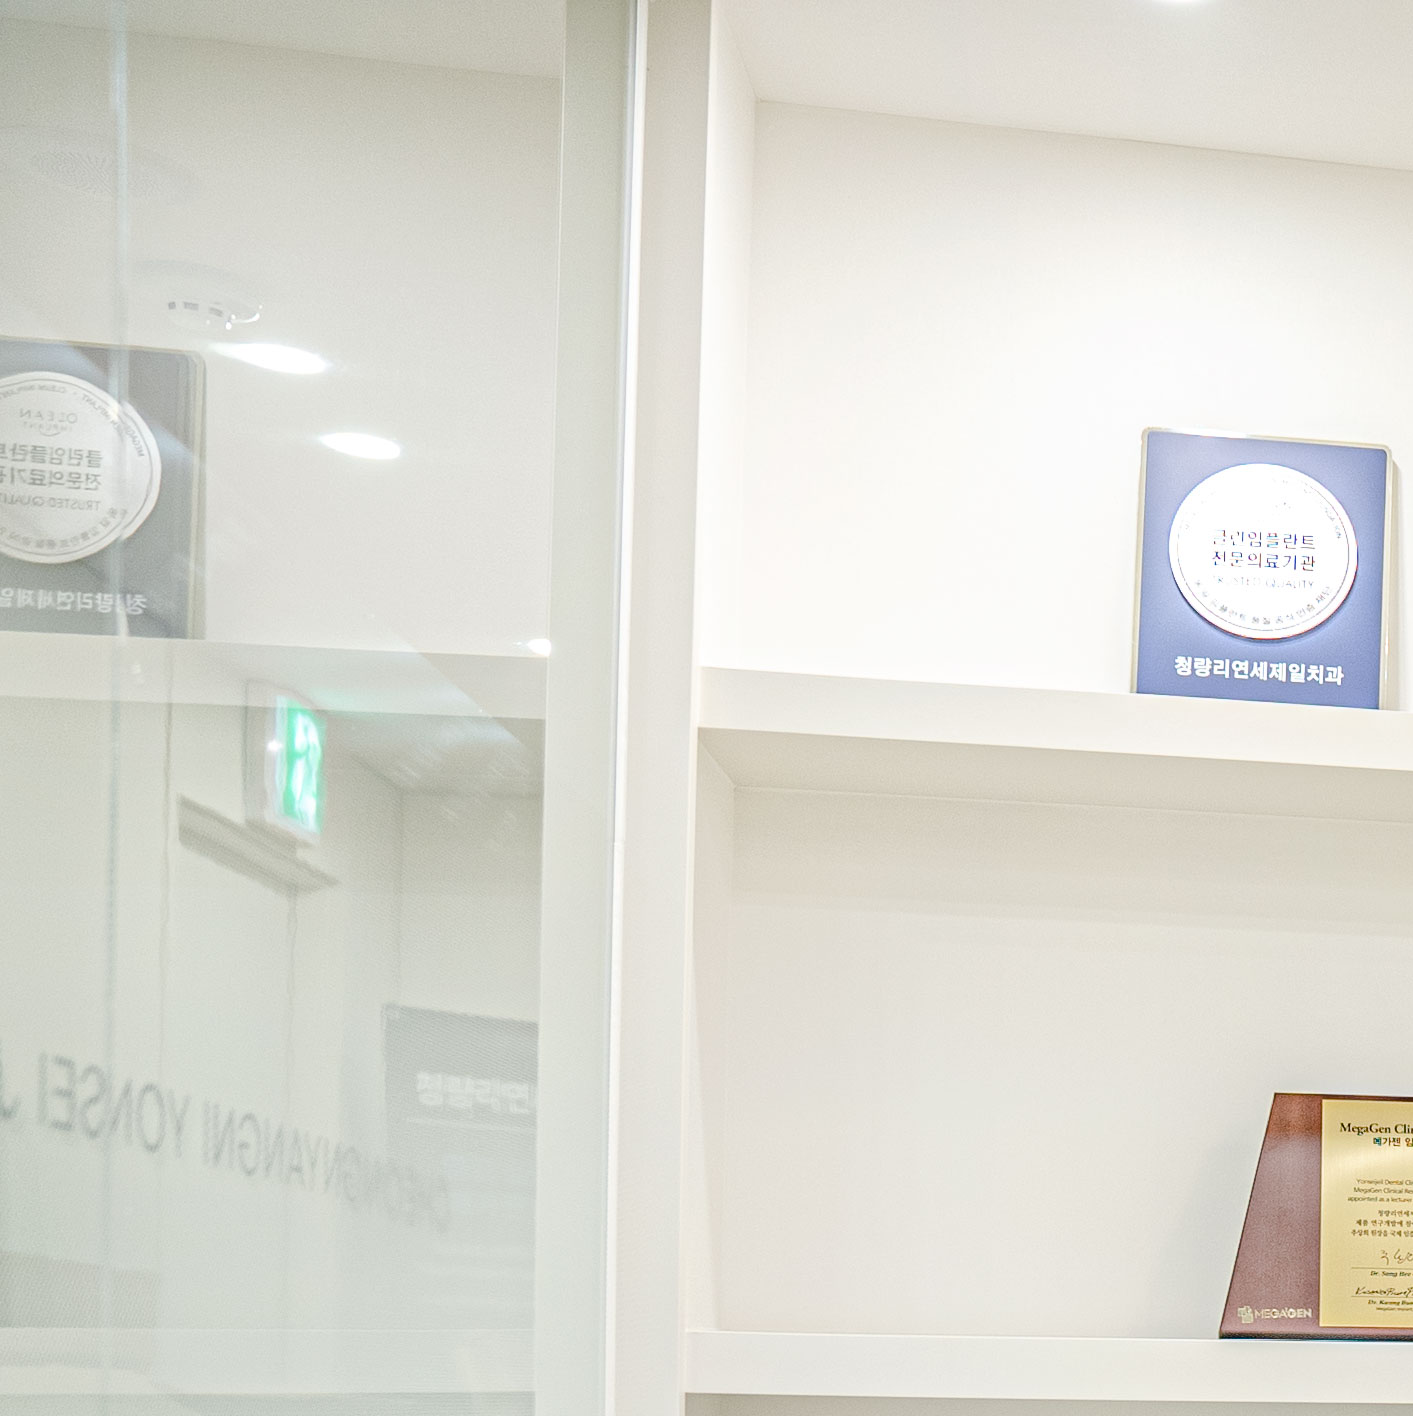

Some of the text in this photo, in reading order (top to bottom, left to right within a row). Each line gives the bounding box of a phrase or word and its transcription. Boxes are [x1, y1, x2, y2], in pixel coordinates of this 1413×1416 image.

[1212, 551, 1316, 571] 전문의료기관
[1174, 656, 1344, 685] 청량리연세제일치과
[1340, 1122, 1391, 1136] MegaGen
[1373, 1137, 1401, 1147] 메가젠
[1255, 1307, 1312, 1320] MEGAGEN
